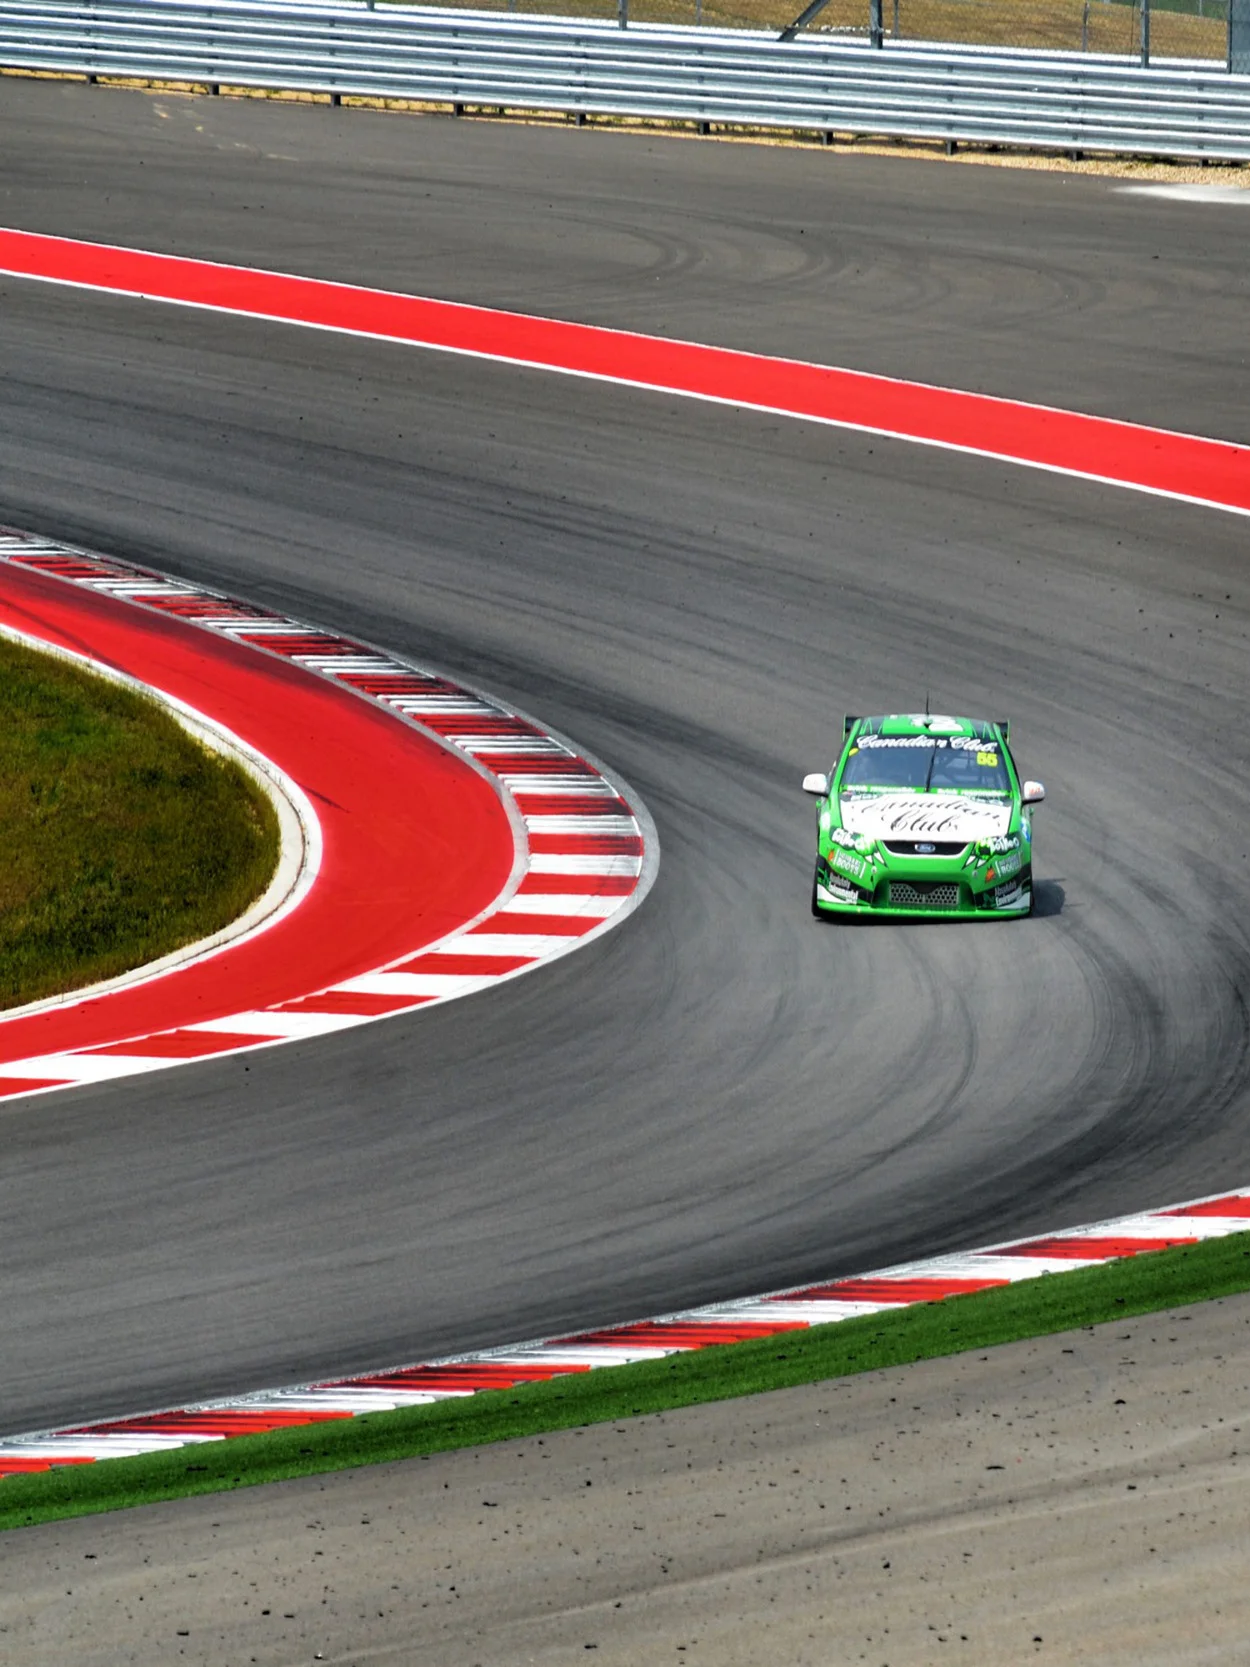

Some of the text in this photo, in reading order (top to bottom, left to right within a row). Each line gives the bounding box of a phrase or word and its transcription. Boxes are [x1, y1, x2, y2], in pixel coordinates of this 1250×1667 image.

[856, 734, 997, 753] Canadian Club
[976, 752, 998, 767] 55
[860, 800, 1000, 820] Canadian
[880, 809, 959, 832] Club
